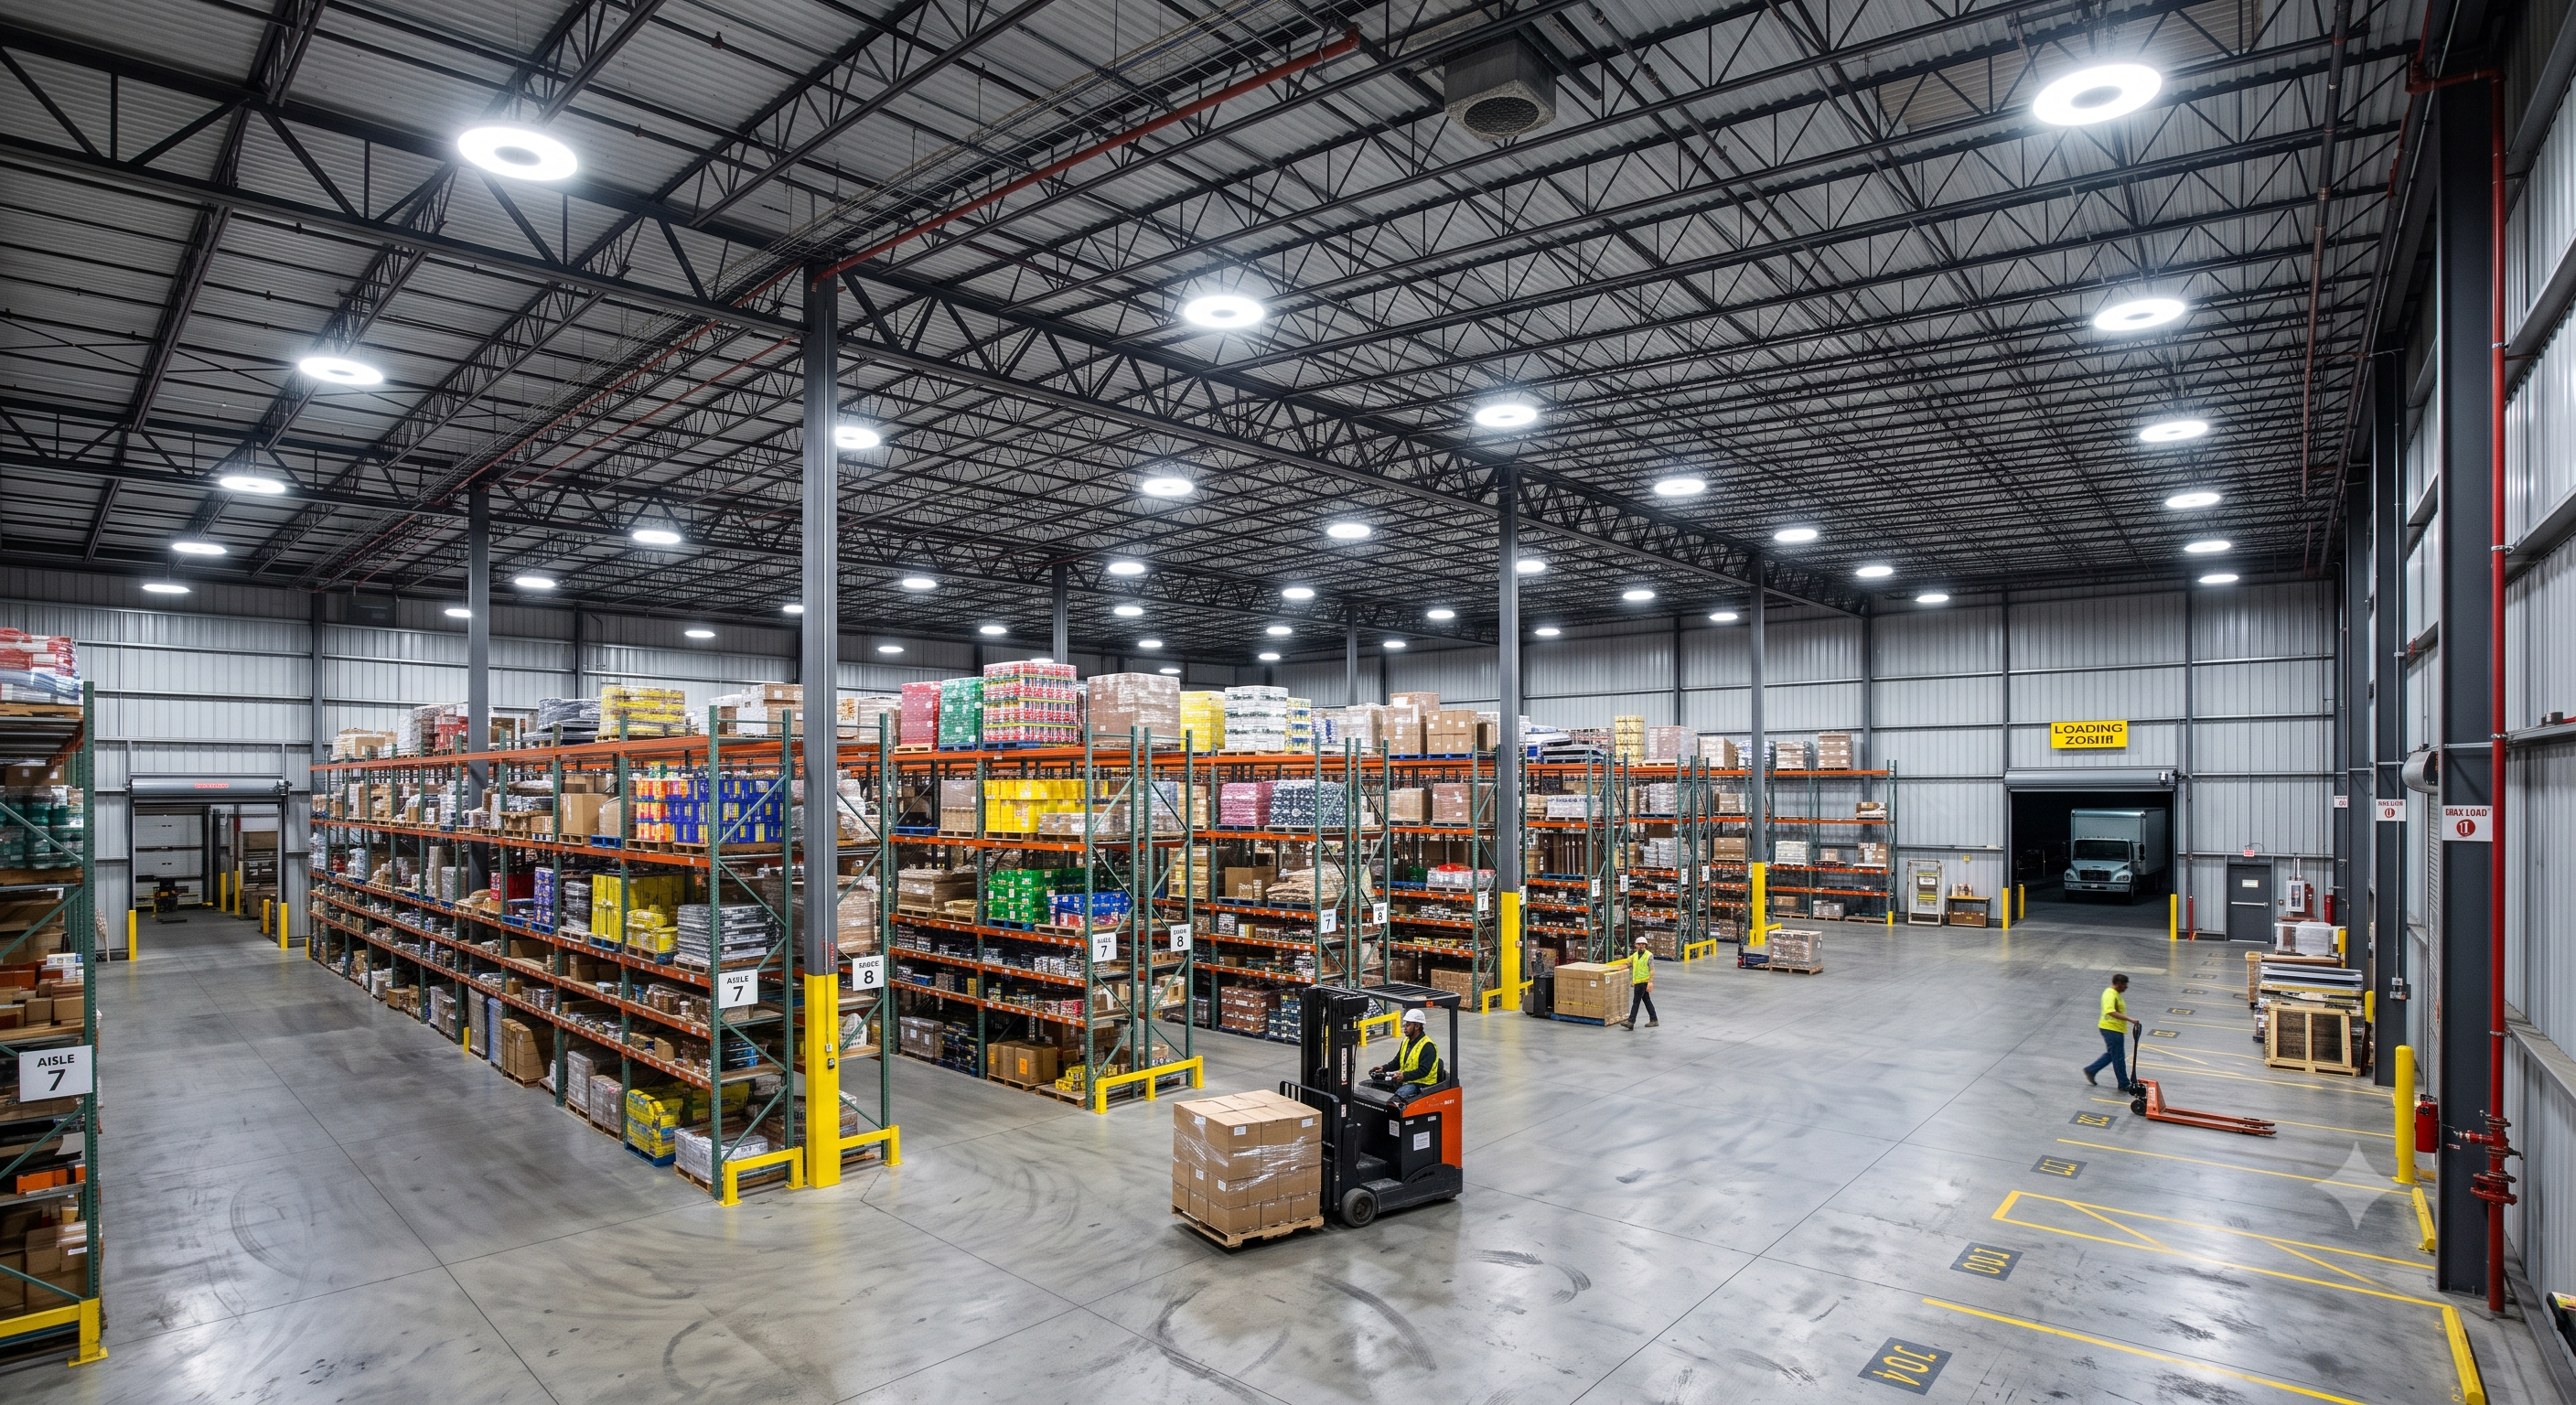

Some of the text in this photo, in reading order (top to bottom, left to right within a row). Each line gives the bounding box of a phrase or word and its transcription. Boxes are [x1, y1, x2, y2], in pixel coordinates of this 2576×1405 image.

[2055, 724, 2123, 734] LOADING
[2465, 809, 2487, 817] LOAD
[1176, 936, 1184, 948] 8
[1100, 945, 1108, 958] 7
[864, 970, 875, 984] 8
[733, 985, 744, 1002] 7
[37, 1054, 75, 1068] AISLE
[48, 1068, 66, 1092] 7
